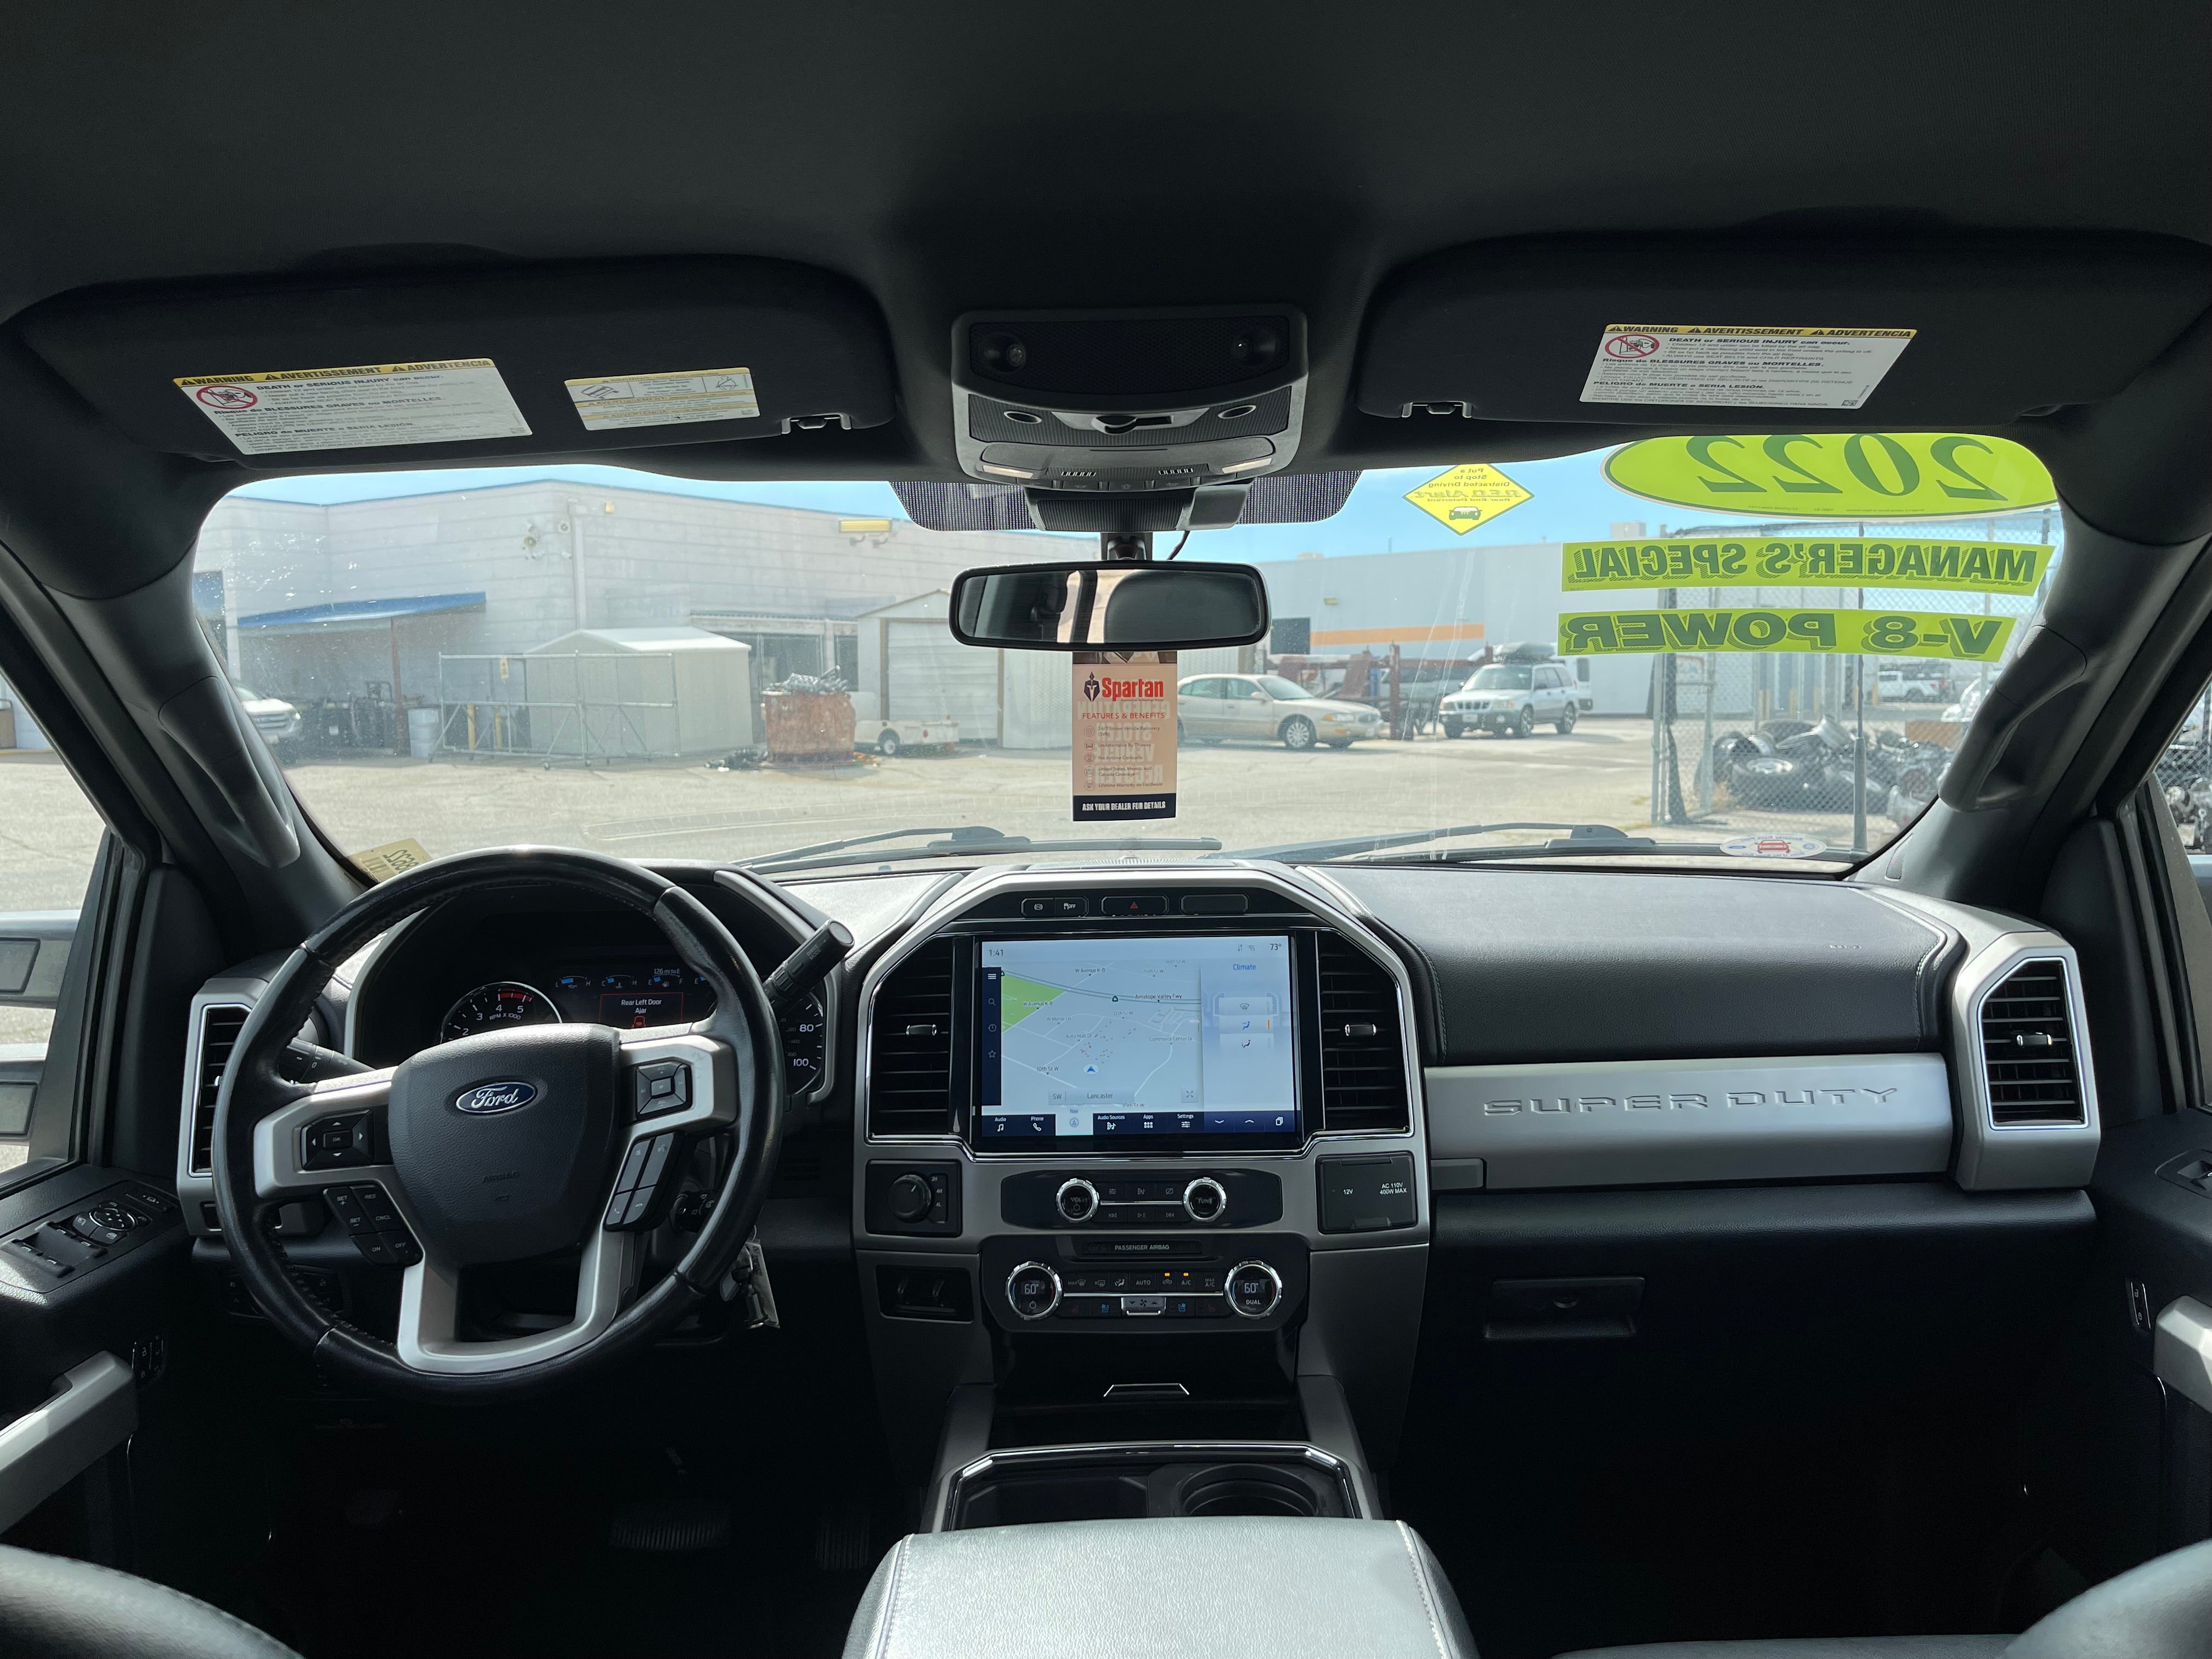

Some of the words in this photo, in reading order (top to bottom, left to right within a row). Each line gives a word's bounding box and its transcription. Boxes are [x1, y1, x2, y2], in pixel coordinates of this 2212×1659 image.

[1703, 327, 1804, 336] AVERTISSEMENT
[1825, 329, 1912, 337] ADVERTENCIA
[192, 376, 255, 386] WARNING
[280, 366, 382, 380] AVERTISSEMENT
[408, 360, 492, 371] ADVERTENCIA
[1102, 677, 1164, 701] Spartan
[1082, 803, 1094, 811] ASK
[517, 1005, 524, 1013] 5
[799, 1024, 814, 1032] 80
[793, 1058, 809, 1066] 100
[470, 1086, 520, 1109] Ford
[1484, 1093, 1708, 1116] SUPER
[1726, 1088, 1898, 1108] DUTY
[1024, 1283, 1039, 1295] 60°
[1244, 1282, 1259, 1294] 60°
